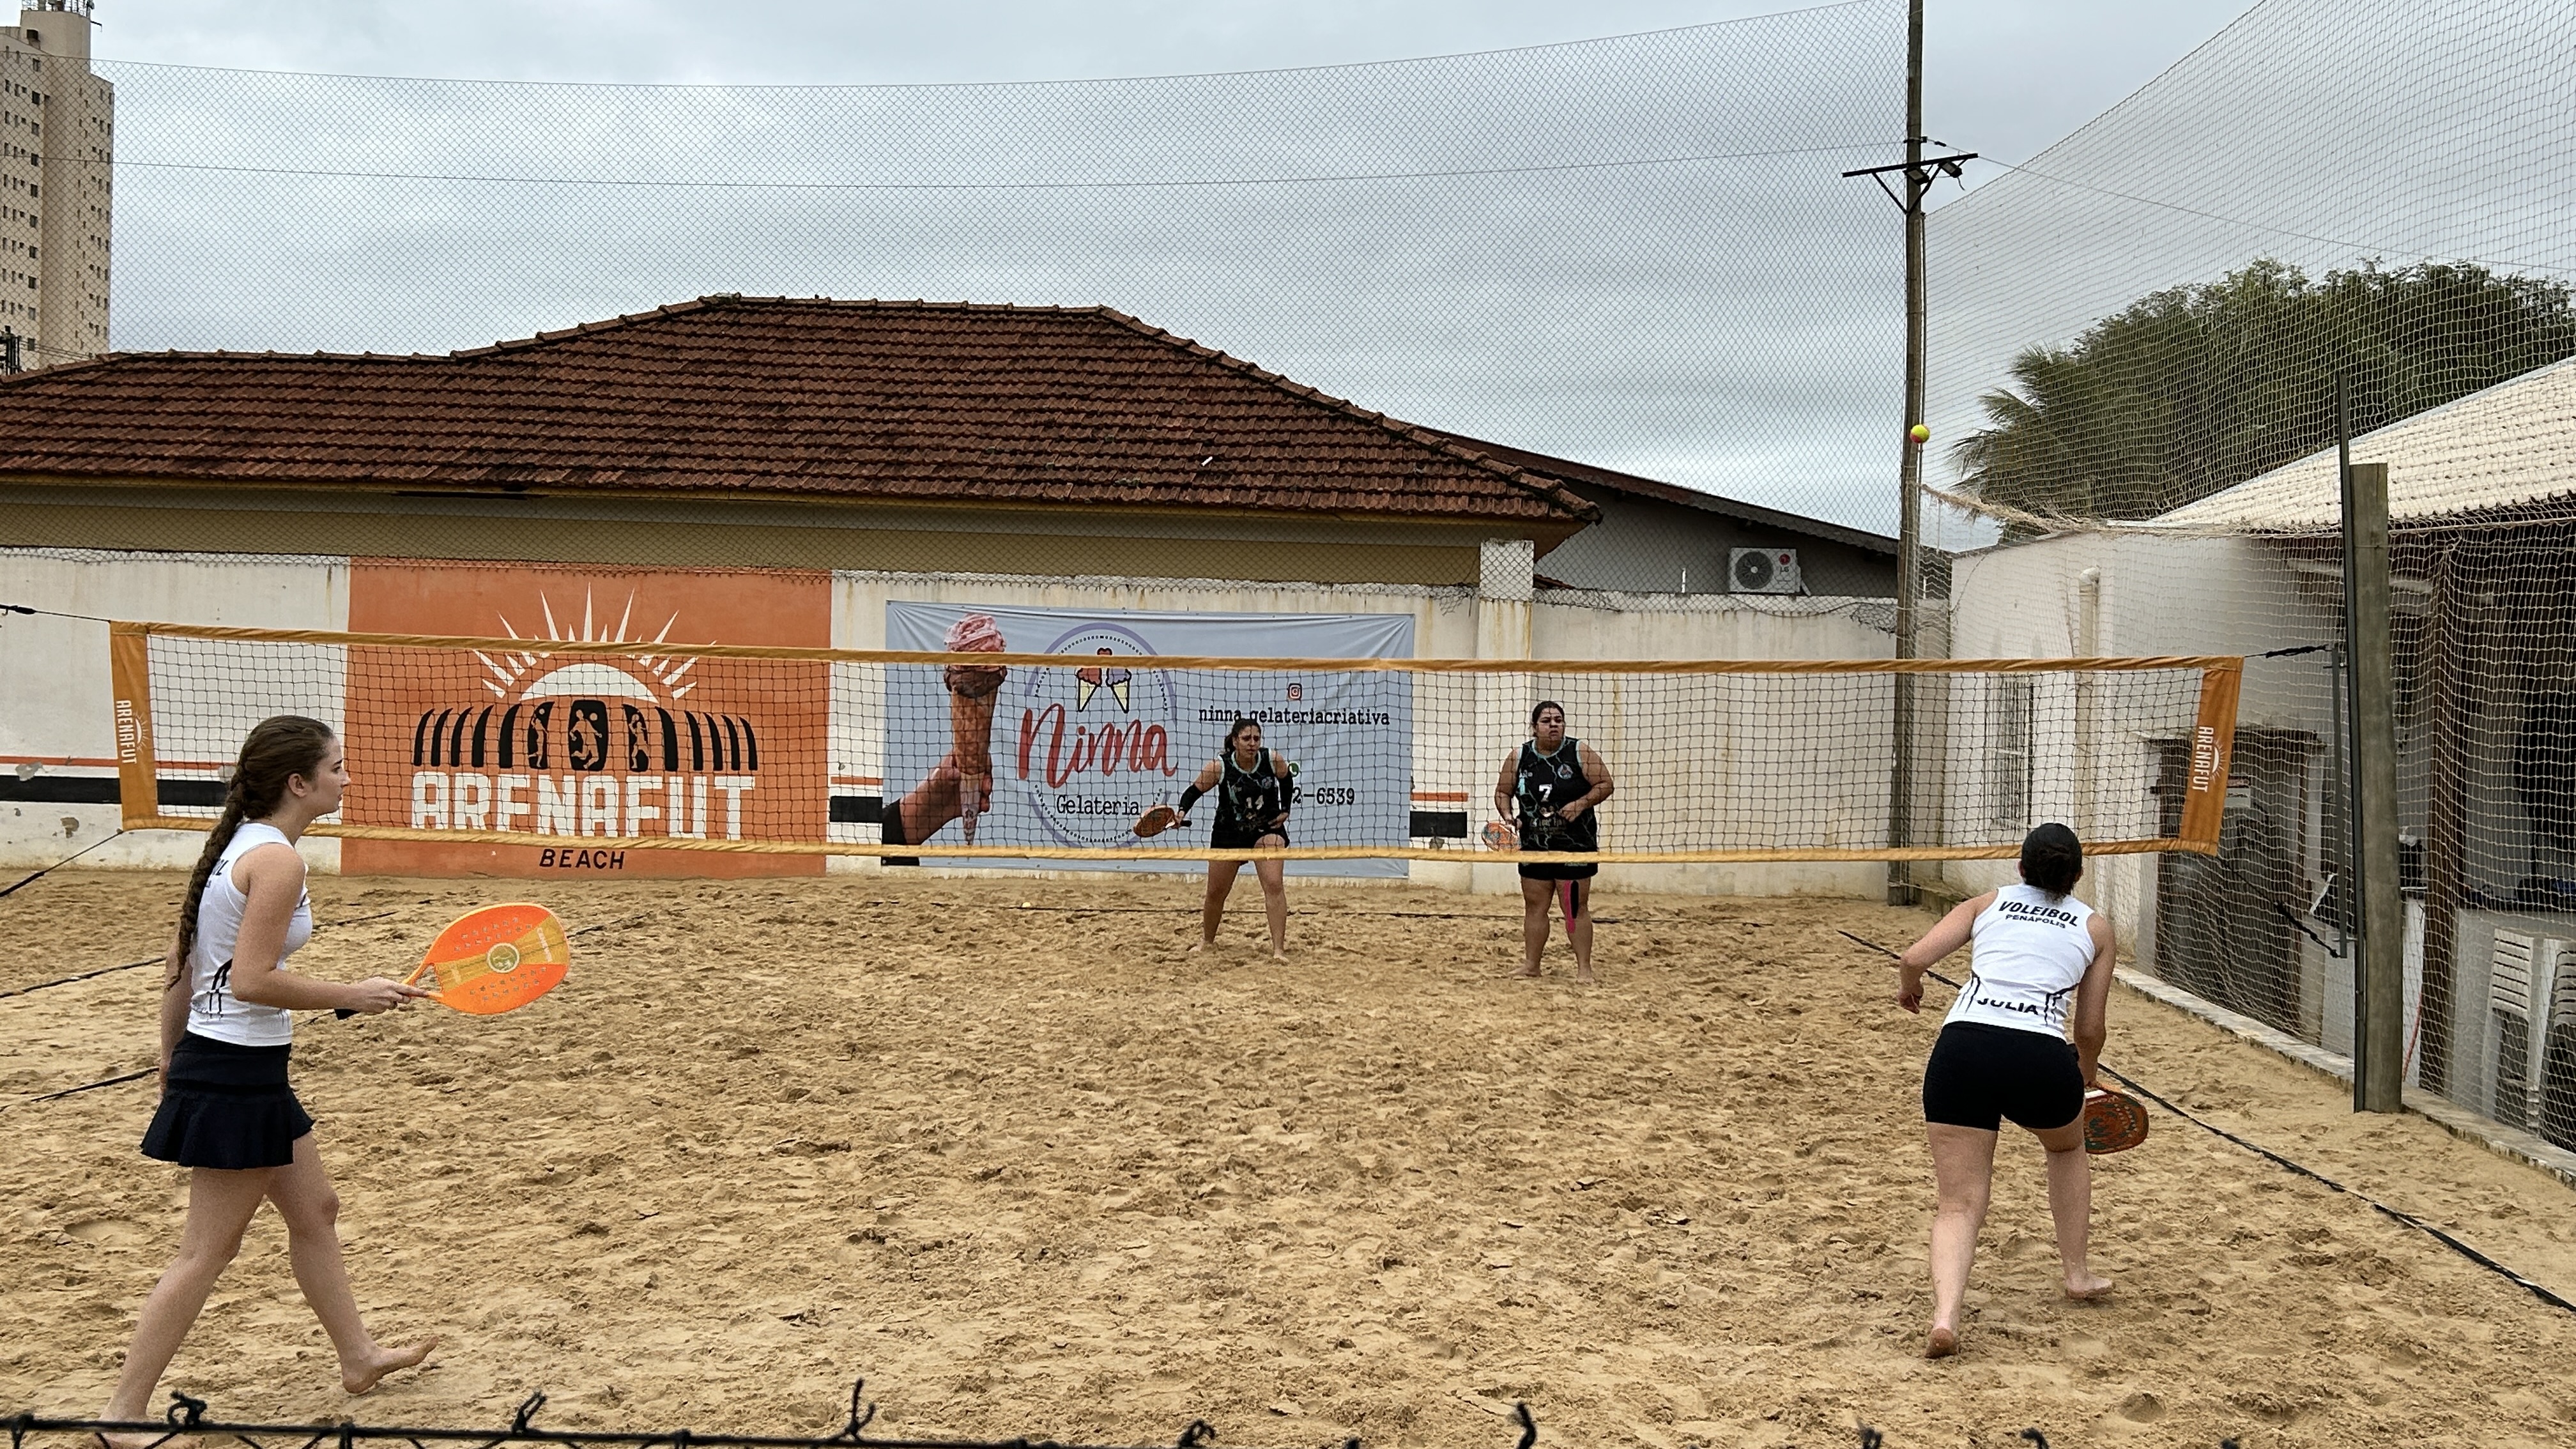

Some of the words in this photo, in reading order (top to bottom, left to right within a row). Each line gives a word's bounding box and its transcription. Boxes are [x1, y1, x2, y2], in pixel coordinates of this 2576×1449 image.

[116, 700, 137, 764] ARENAFUT
[1018, 703, 1179, 789] Ninna
[2192, 726, 2214, 793] ARENAFUT
[1056, 794, 1140, 816] Gelateria
[1246, 795, 1264, 810] 14
[1538, 783, 1552, 802] 7
[411, 771, 756, 841] ARENAFUT
[539, 848, 625, 870] BEACH
[1998, 901, 2078, 927] VOLEIBOL
